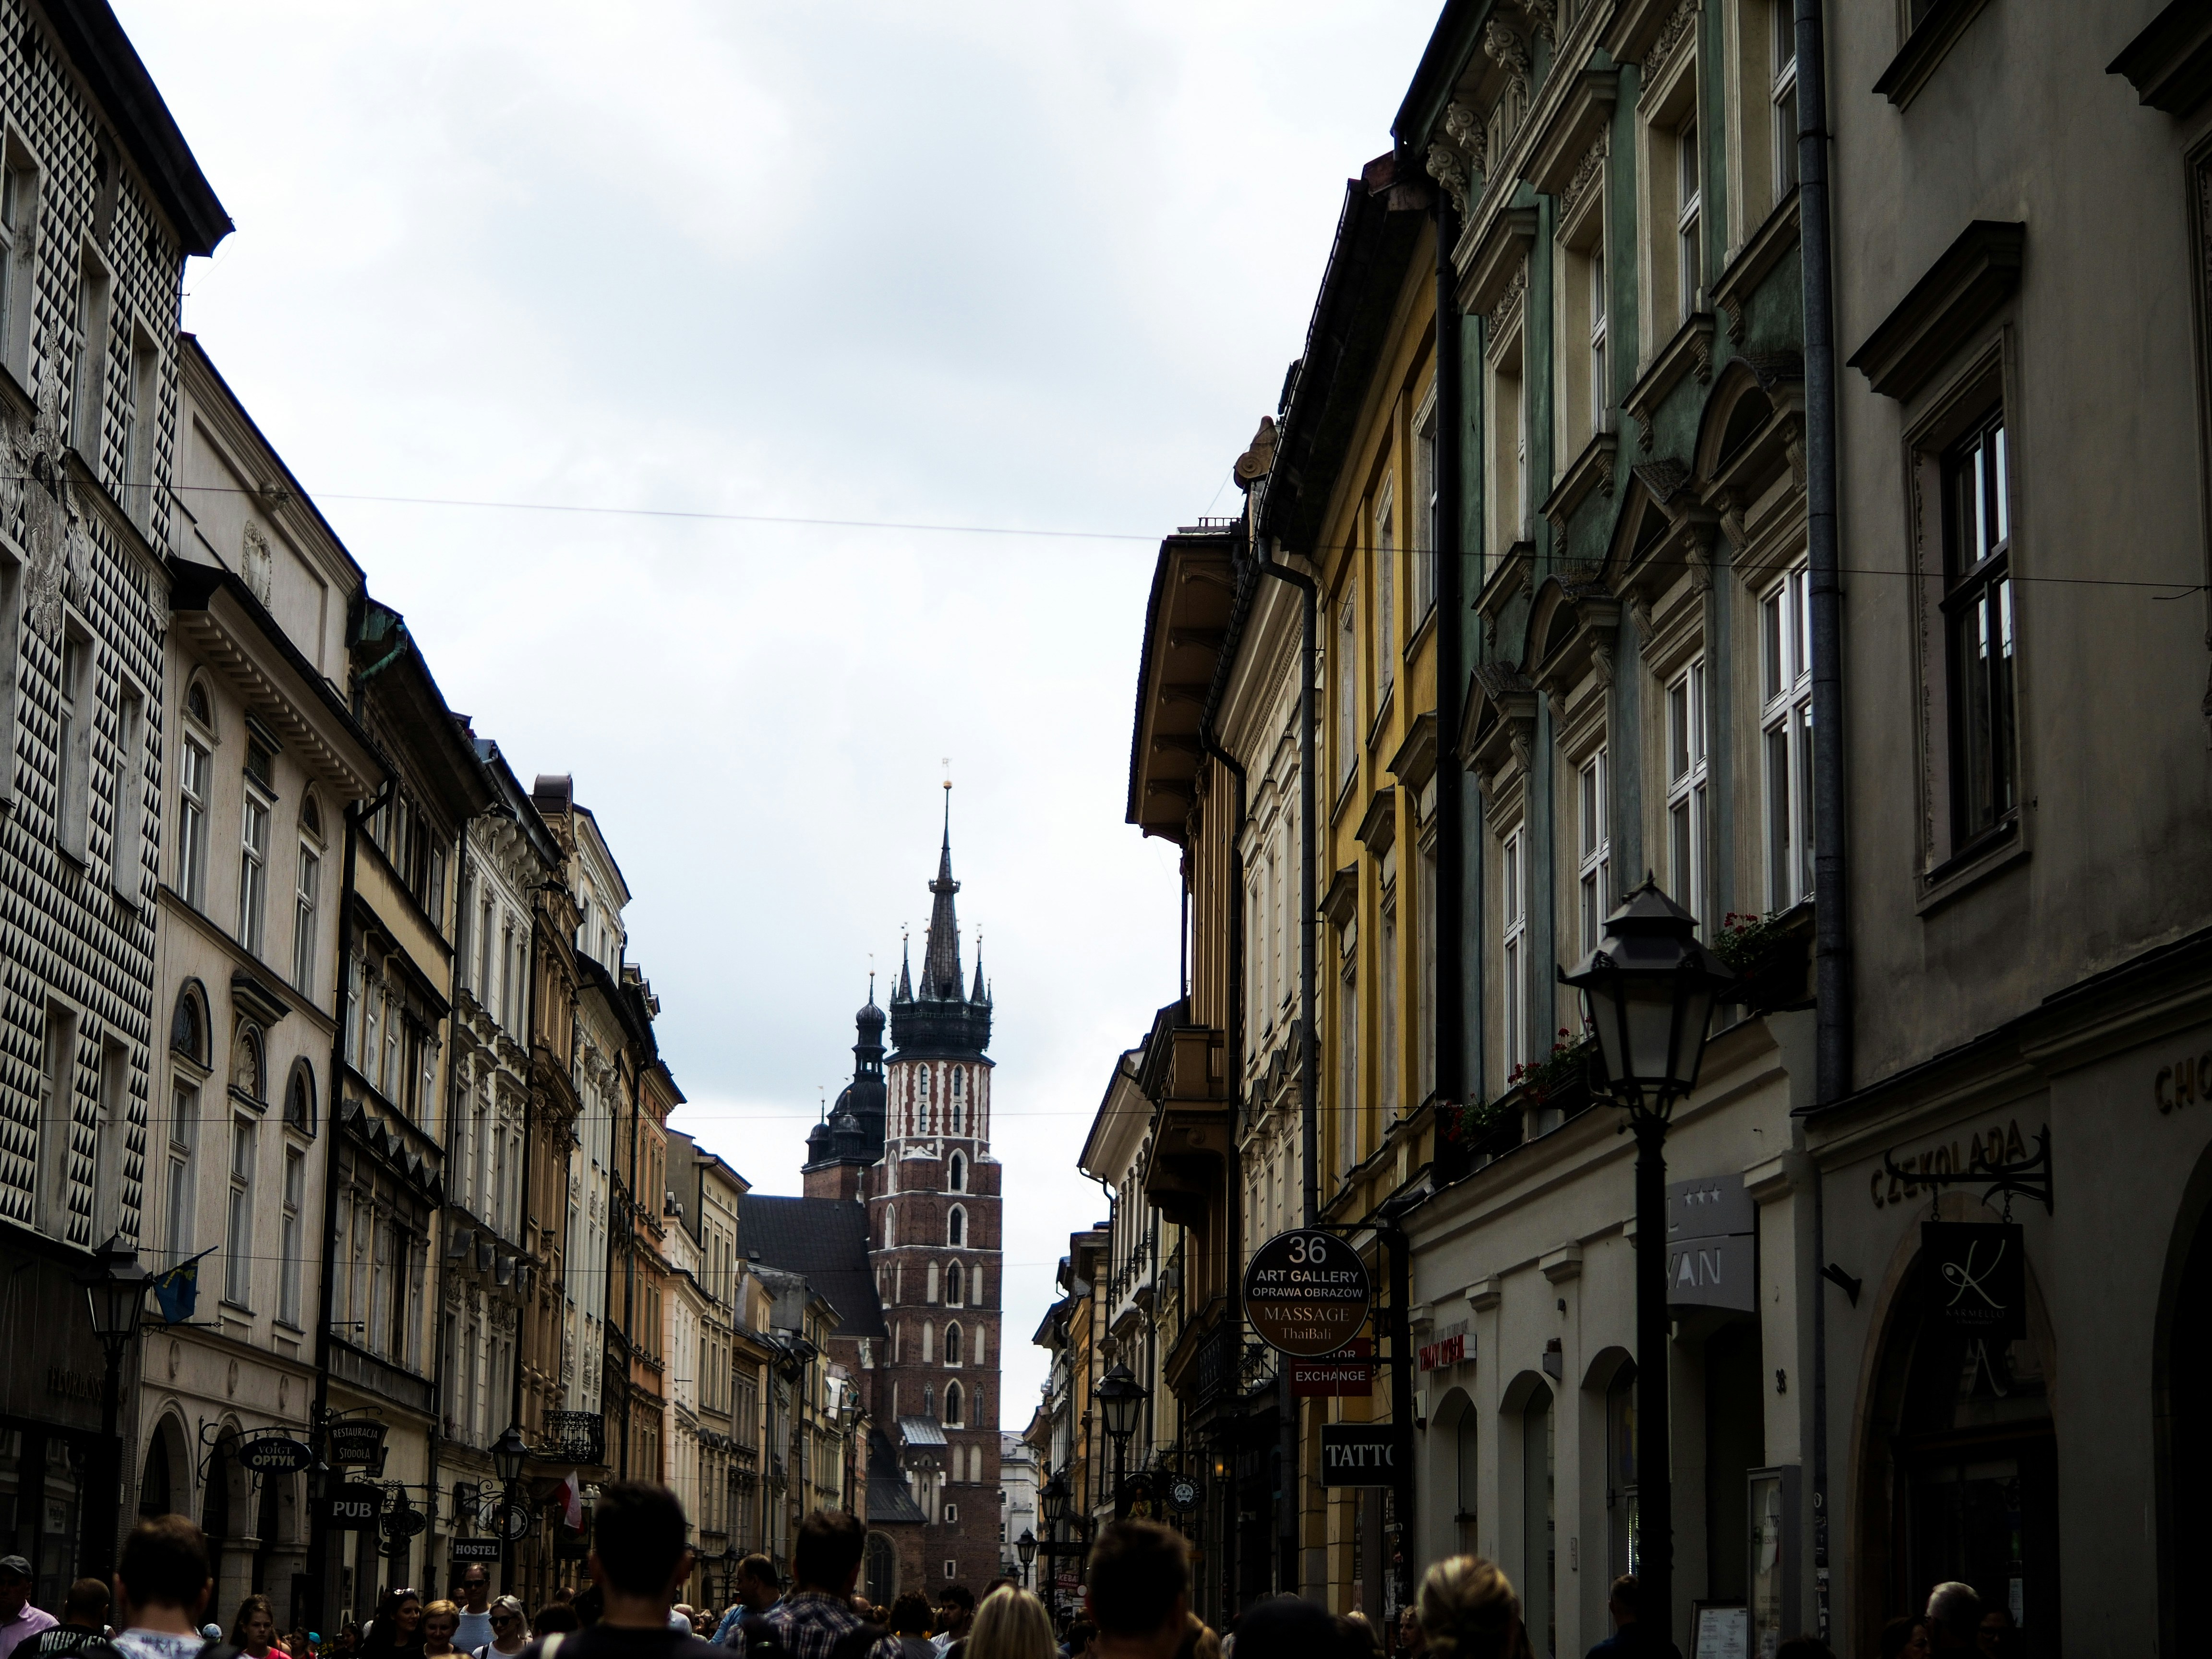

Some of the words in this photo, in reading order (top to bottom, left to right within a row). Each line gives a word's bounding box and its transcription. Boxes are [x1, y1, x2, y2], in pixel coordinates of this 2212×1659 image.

[1871, 1118, 2026, 1208] CZEKOLADA
[1288, 1236, 1326, 1264] 36
[1256, 1270, 1286, 1282] ART
[1291, 1270, 1359, 1283] GALLERY
[1252, 1287, 1302, 1297] OPRAWA
[1304, 1287, 1363, 1298] OBRAZÓW
[1264, 1307, 1350, 1322] MASSAGE
[1946, 1309, 2005, 1318] KARMELLO
[1281, 1327, 1332, 1339] ThaiBali
[1296, 1370, 1366, 1382] EXCHANGE
[333, 1427, 378, 1440] RESTAURACJA
[339, 1447, 371, 1460] STODOŁA
[252, 1455, 296, 1467] OPTYK
[333, 1501, 372, 1517] PUB
[456, 1545, 498, 1555] HOSTEL
[1057, 1544, 1086, 1552] HOTEL
[1058, 1573, 1079, 1583] KEBA
